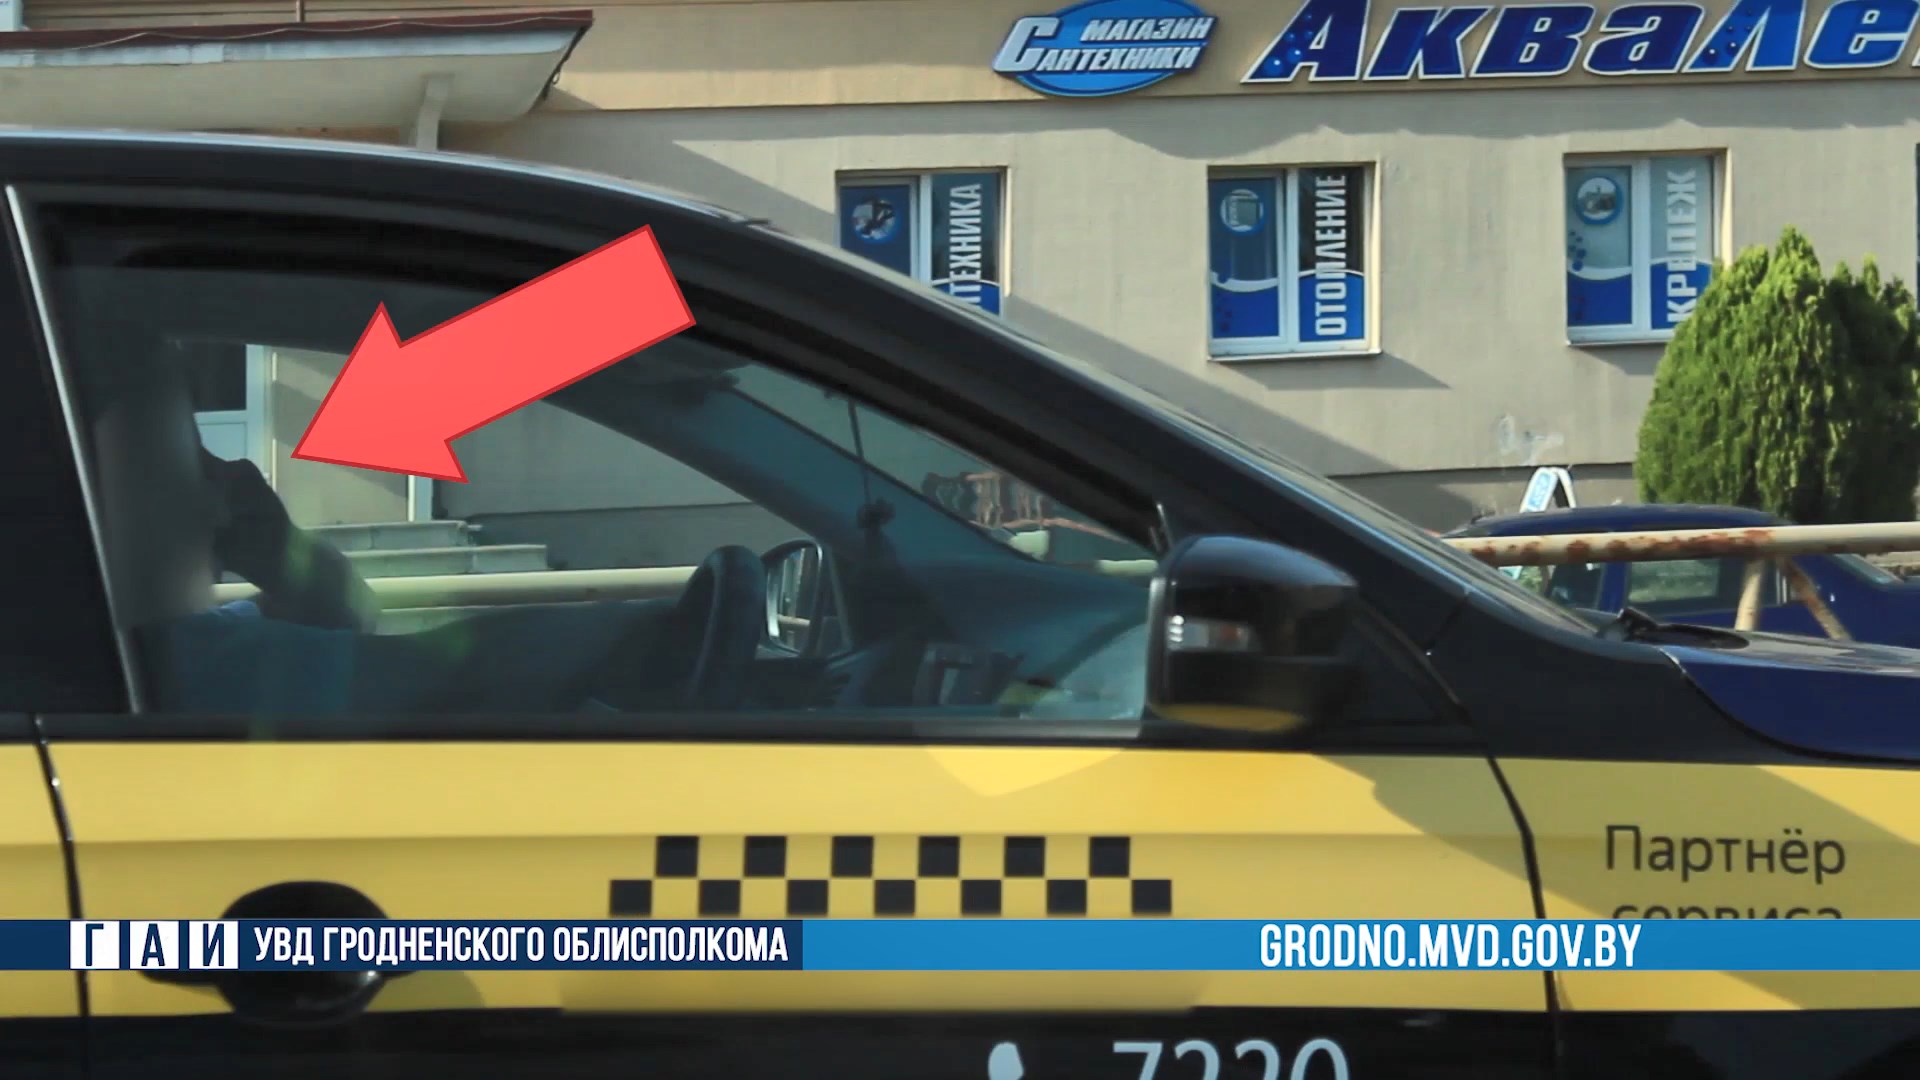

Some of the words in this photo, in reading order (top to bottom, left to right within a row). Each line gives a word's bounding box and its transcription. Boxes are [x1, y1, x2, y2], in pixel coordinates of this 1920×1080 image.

[1080, 17, 1214, 42] МАГАЗИН
[1315, 175, 1347, 336] ОТОПЛЕНИЕ
[1666, 168, 1697, 323] КРЕПЕЖ
[1606, 825, 1846, 885] Партнёр
